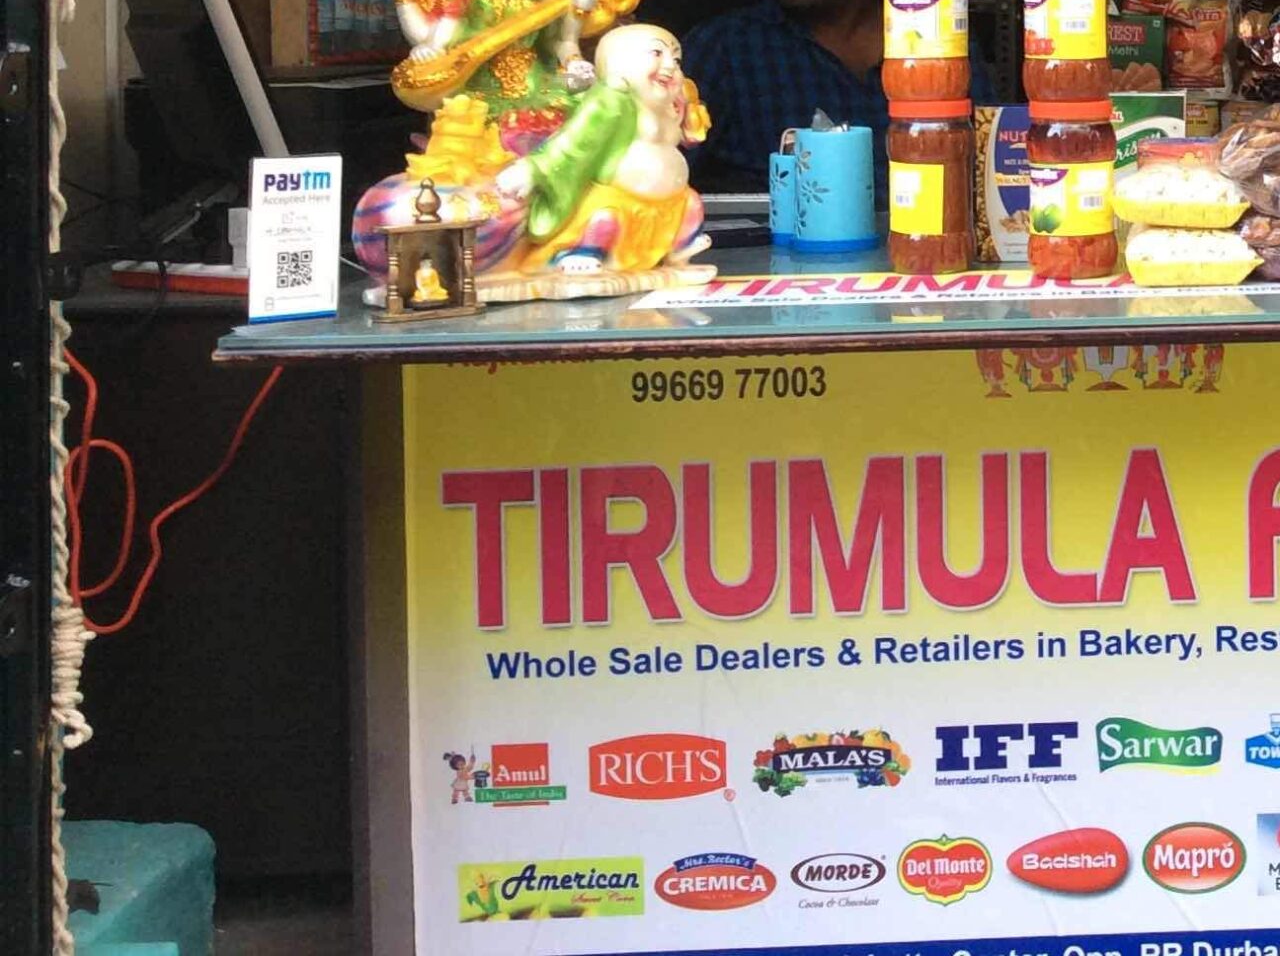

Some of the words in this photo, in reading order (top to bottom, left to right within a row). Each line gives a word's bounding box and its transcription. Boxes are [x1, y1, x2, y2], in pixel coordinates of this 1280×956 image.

[262, 194, 306, 205] Accepted
[308, 194, 331, 203] Here
[631, 370, 724, 403] 99669
[734, 365, 827, 399] 77003
[440, 448, 1198, 630] TIRUMULA
[486, 650, 597, 680] Whole
[608, 646, 683, 675] Sale
[695, 642, 826, 672] Dealers
[838, 639, 863, 668] &
[875, 635, 1025, 664] Retailers
[1035, 632, 1067, 660] in
[1079, 628, 1203, 661] Bakery,
[935, 721, 1079, 772] IFF
[1100, 722, 1219, 762] Sarwar
[599, 747, 722, 787] RICH'S
[778, 748, 887, 773] MALA'S
[494, 764, 547, 783] Amul
[934, 773, 990, 787] International
[991, 773, 1022, 785] Flavors
[1023, 773, 1030, 784] &
[1031, 772, 1078, 785] Fragrances
[803, 862, 873, 883] MORDE
[905, 858, 938, 877] Del
[940, 855, 986, 875] Monte
[1022, 852, 1117, 871] Badshah
[500, 864, 640, 901] American
[663, 874, 768, 897] CREMICA
[928, 876, 963, 890] Quality
[798, 898, 827, 909] Cocoa
[827, 898, 836, 908] &
[837, 895, 880, 908] Chocolate
